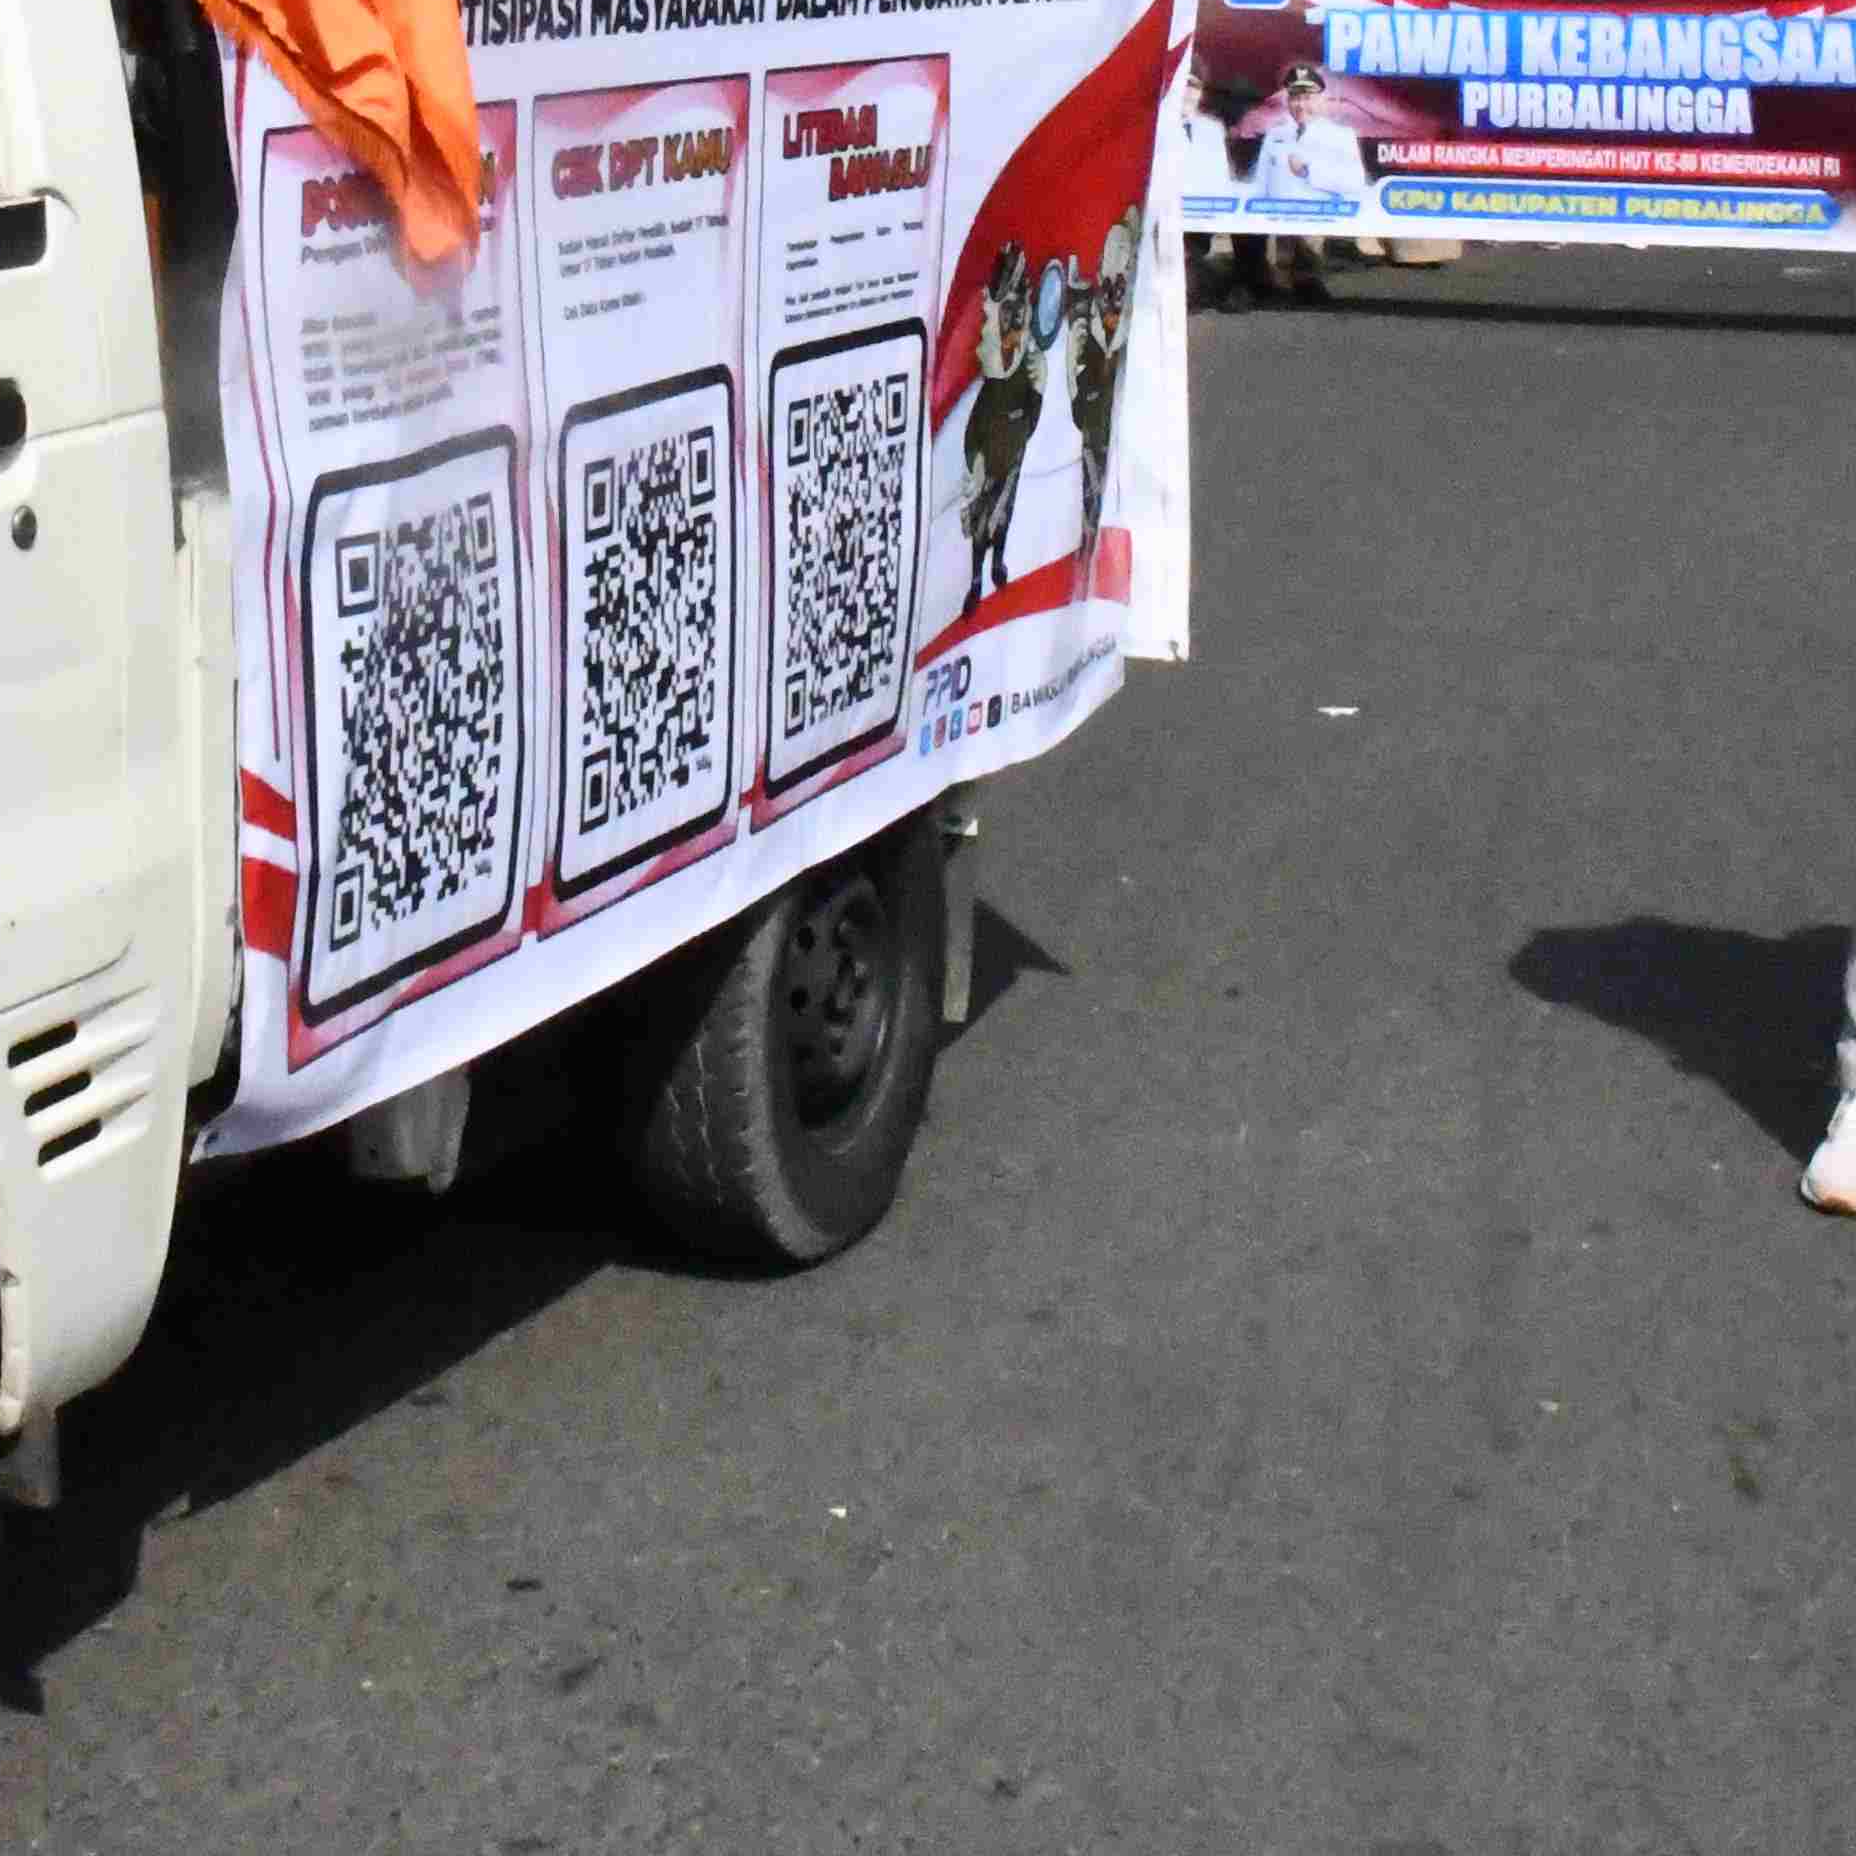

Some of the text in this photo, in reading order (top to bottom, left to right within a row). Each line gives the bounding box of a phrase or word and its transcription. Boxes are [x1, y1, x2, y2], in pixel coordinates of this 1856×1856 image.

[1328, 12, 1507, 76] PAWAI
[783, 104, 878, 160] LITERASI
[1462, 80, 1754, 135] PURBALINGGA
[551, 144, 604, 200] CEK
[609, 136, 659, 192] DPT
[663, 126, 735, 184] KAMU
[828, 144, 933, 203] BAWASLU
[1377, 143, 1433, 164] DALAM
[1434, 145, 1500, 166] RANGKA
[1619, 150, 1652, 171] HUT
[1823, 157, 1841, 178] RI
[1388, 189, 1445, 211] KPU
[1451, 190, 1618, 216] KABUPATEN
[1625, 196, 1825, 225] PURBALINGGA
